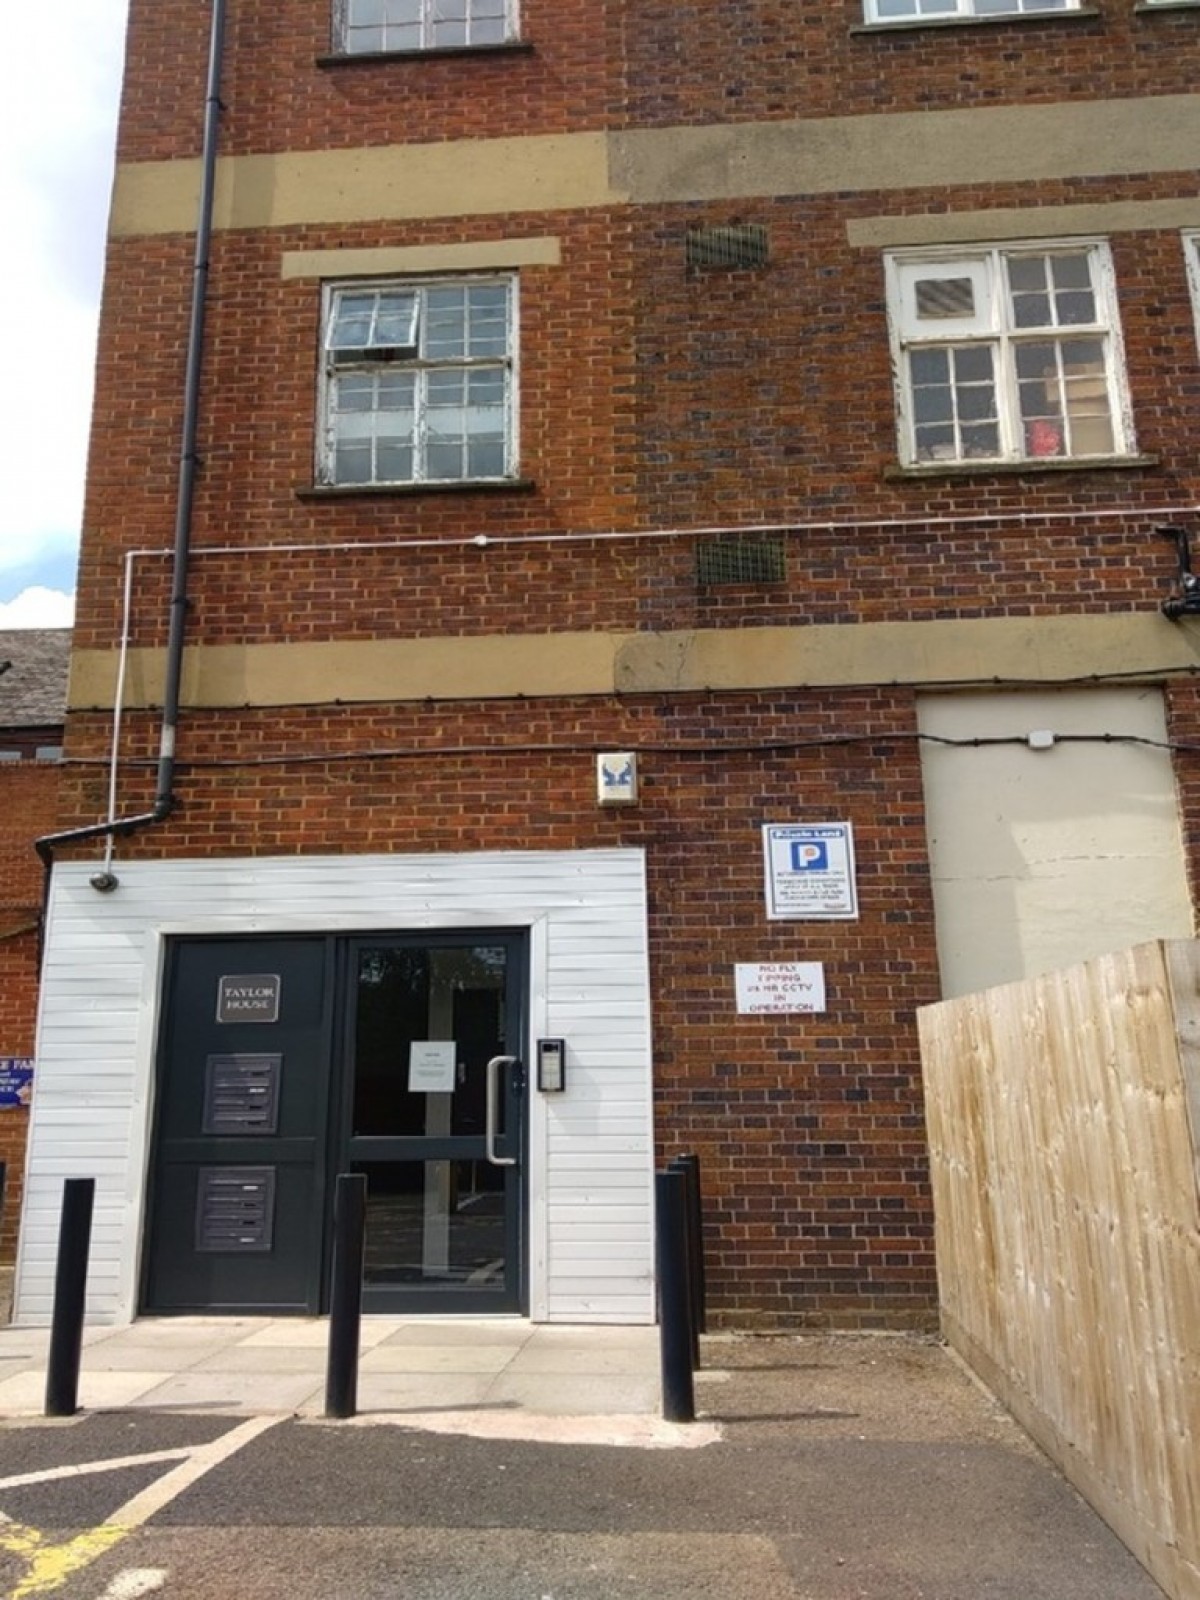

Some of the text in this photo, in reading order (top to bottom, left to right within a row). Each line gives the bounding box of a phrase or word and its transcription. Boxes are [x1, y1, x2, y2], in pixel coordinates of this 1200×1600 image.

[798, 844, 821, 867] P
[225, 987, 274, 997] TAYLOR
[782, 983, 813, 992] CCTV
[227, 999, 270, 1009] HOUSE
